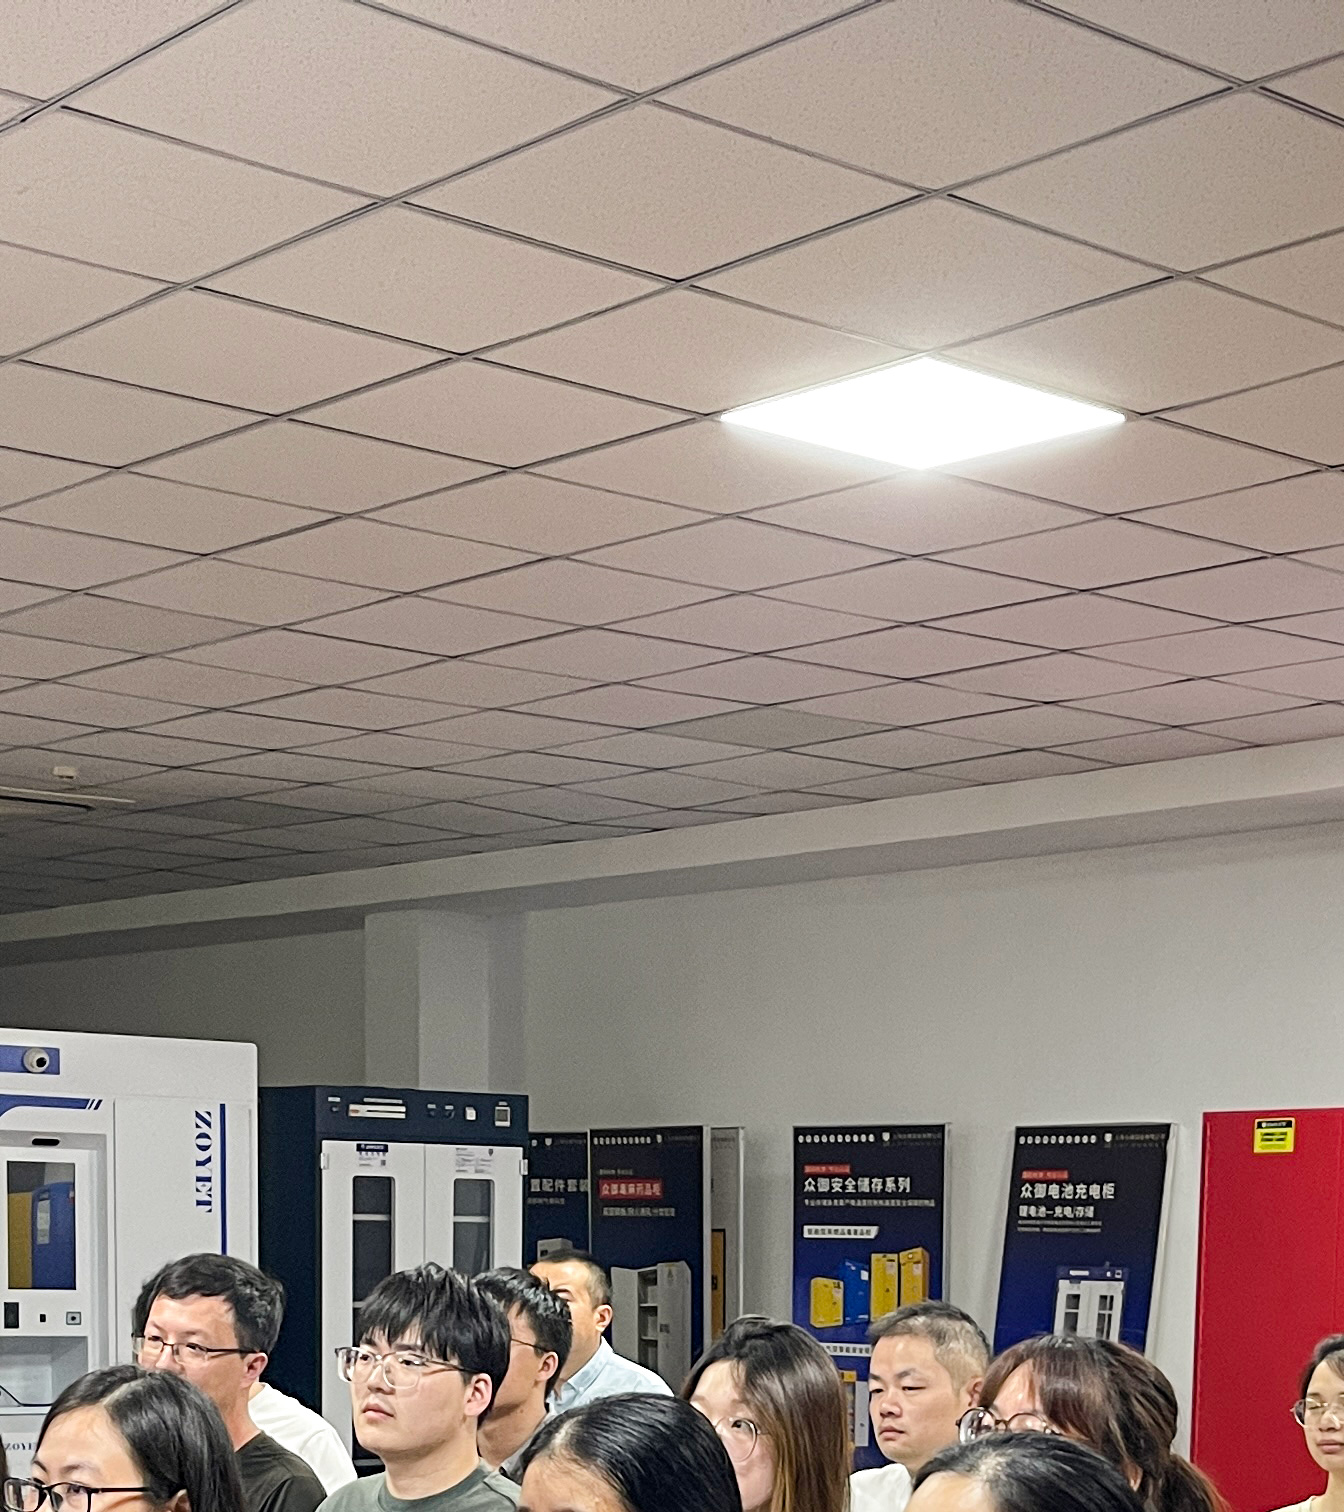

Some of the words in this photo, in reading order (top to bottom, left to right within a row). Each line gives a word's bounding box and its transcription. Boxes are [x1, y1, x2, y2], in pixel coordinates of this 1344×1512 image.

[195, 1110, 212, 1213] ZOYET
[804, 1176, 911, 1193] 众御安全储存系列
[1019, 1182, 1115, 1200] 众御电池充电柜
